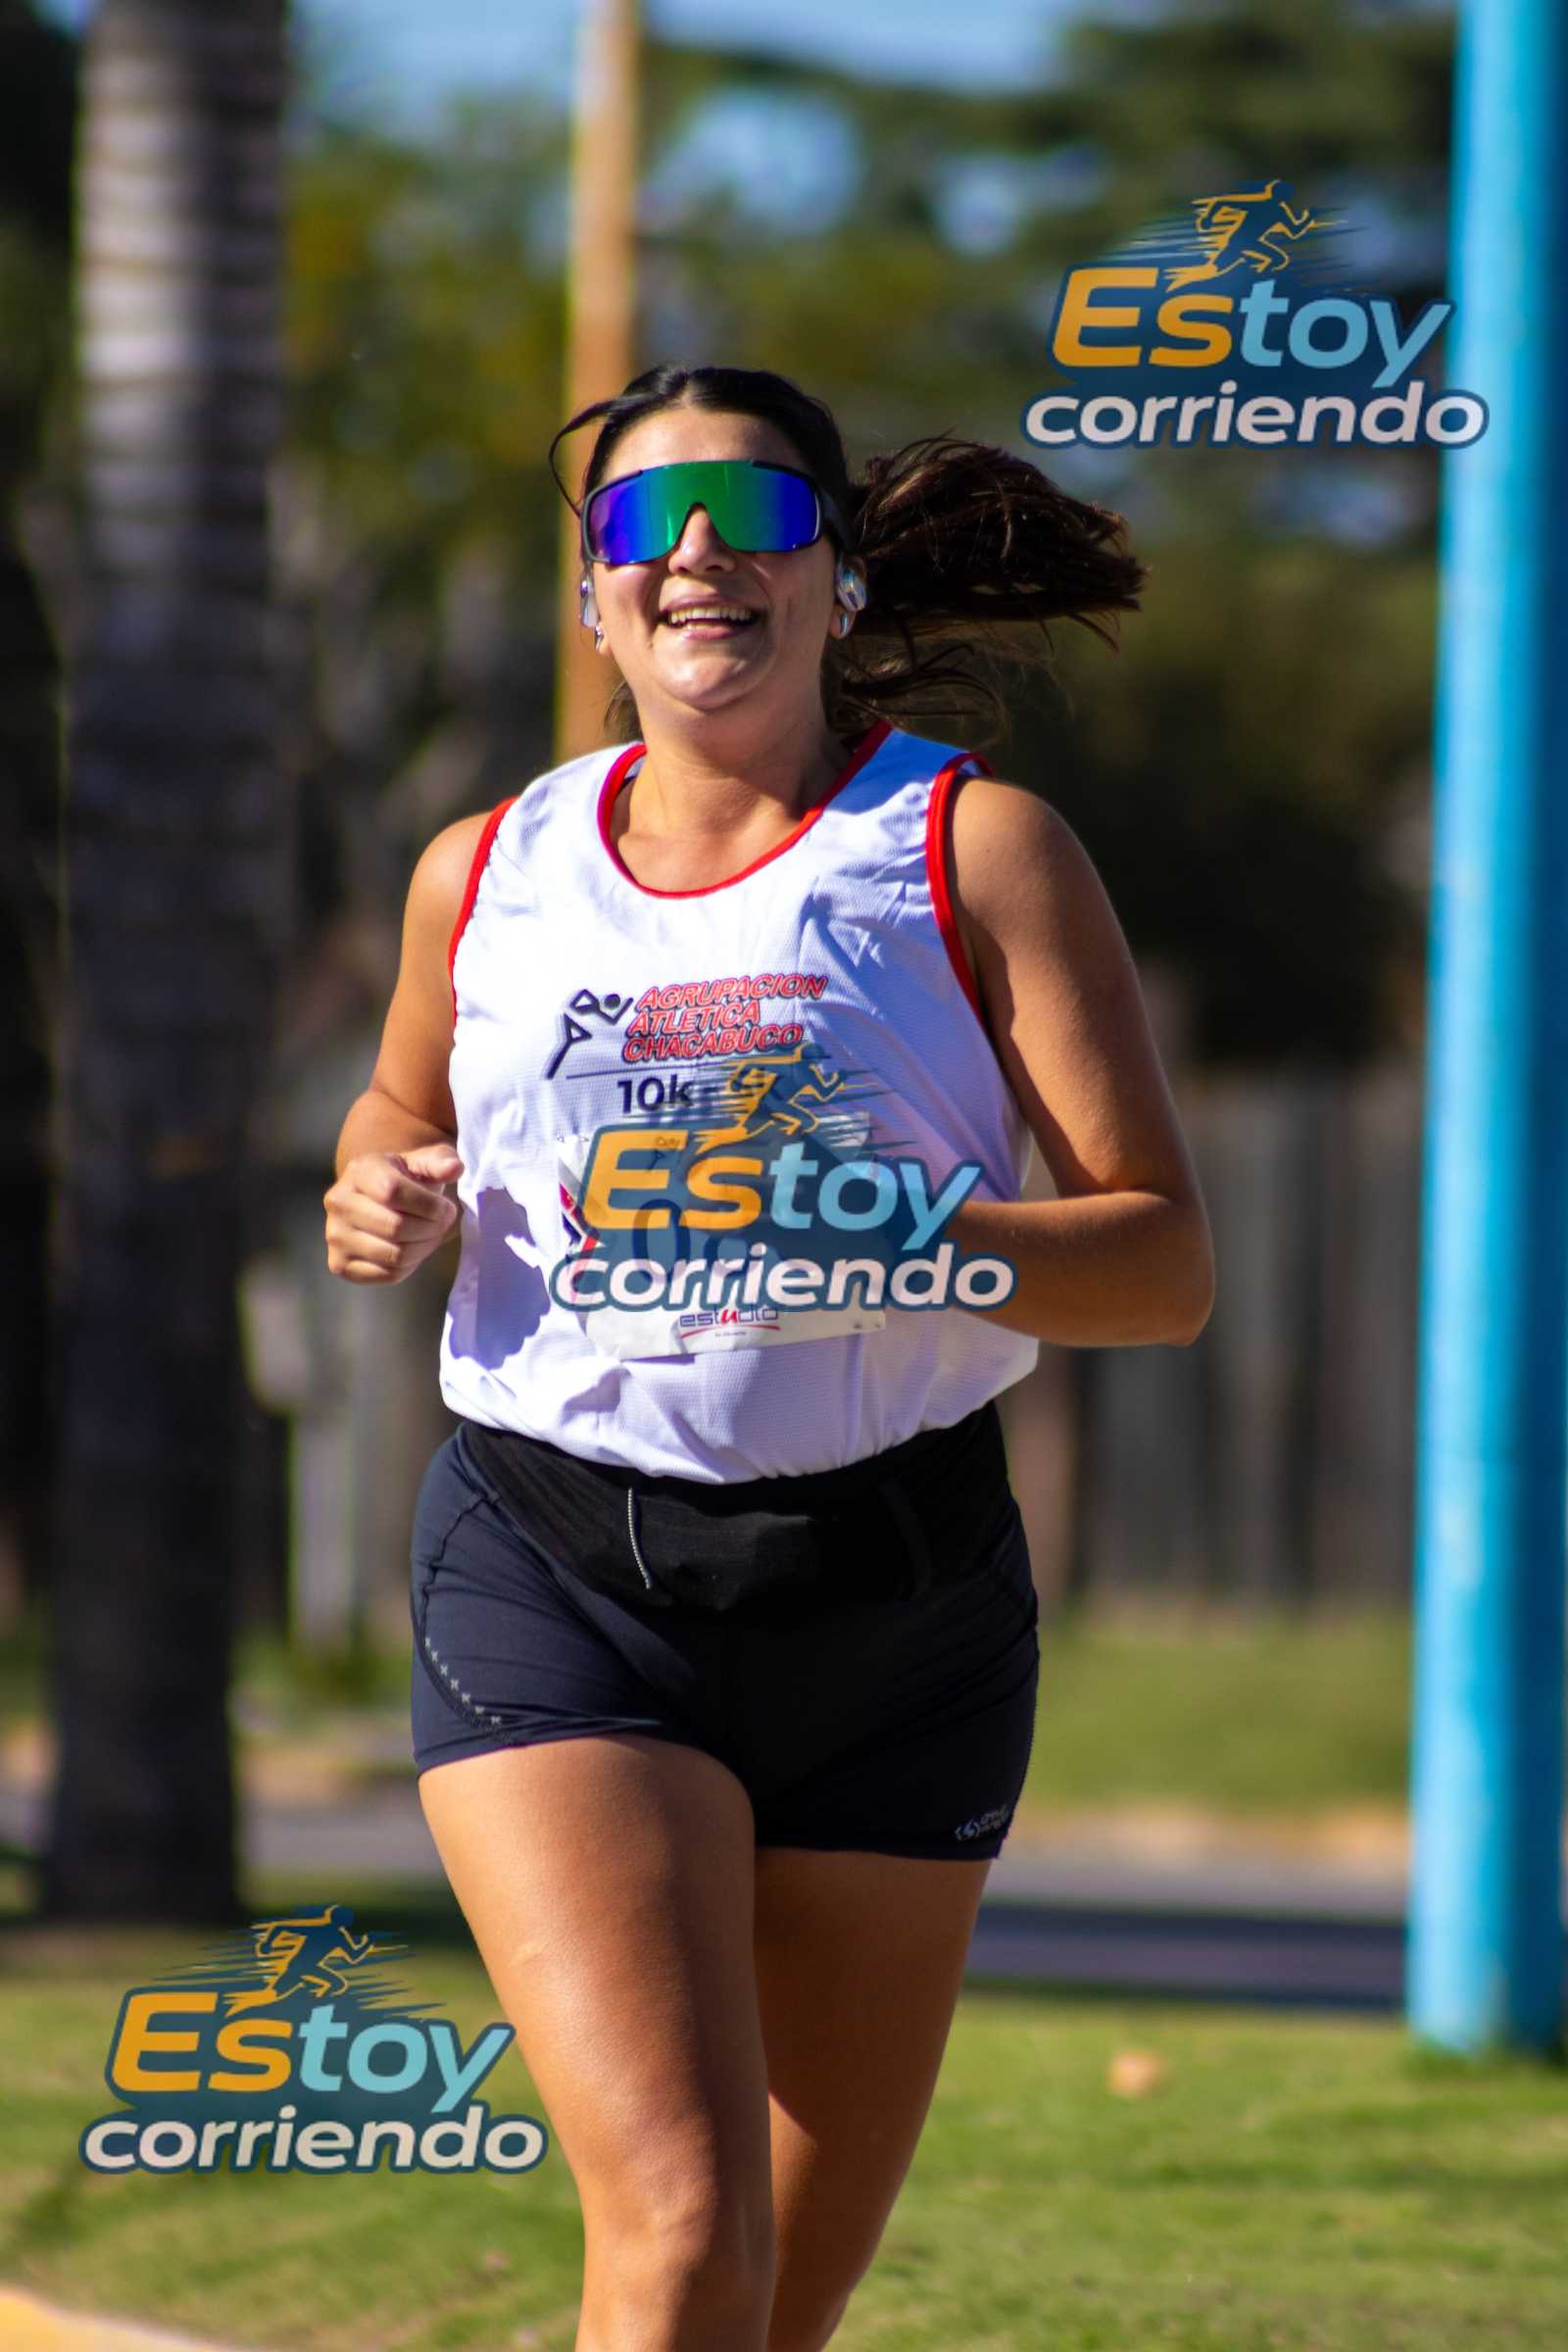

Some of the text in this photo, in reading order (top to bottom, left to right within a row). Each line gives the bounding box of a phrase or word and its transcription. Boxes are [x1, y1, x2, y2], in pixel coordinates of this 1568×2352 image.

[635, 973, 829, 1012] AGRUPACION
[626, 999, 761, 1037] ATLETICA
[621, 1023, 804, 1062] CHACABUCO
